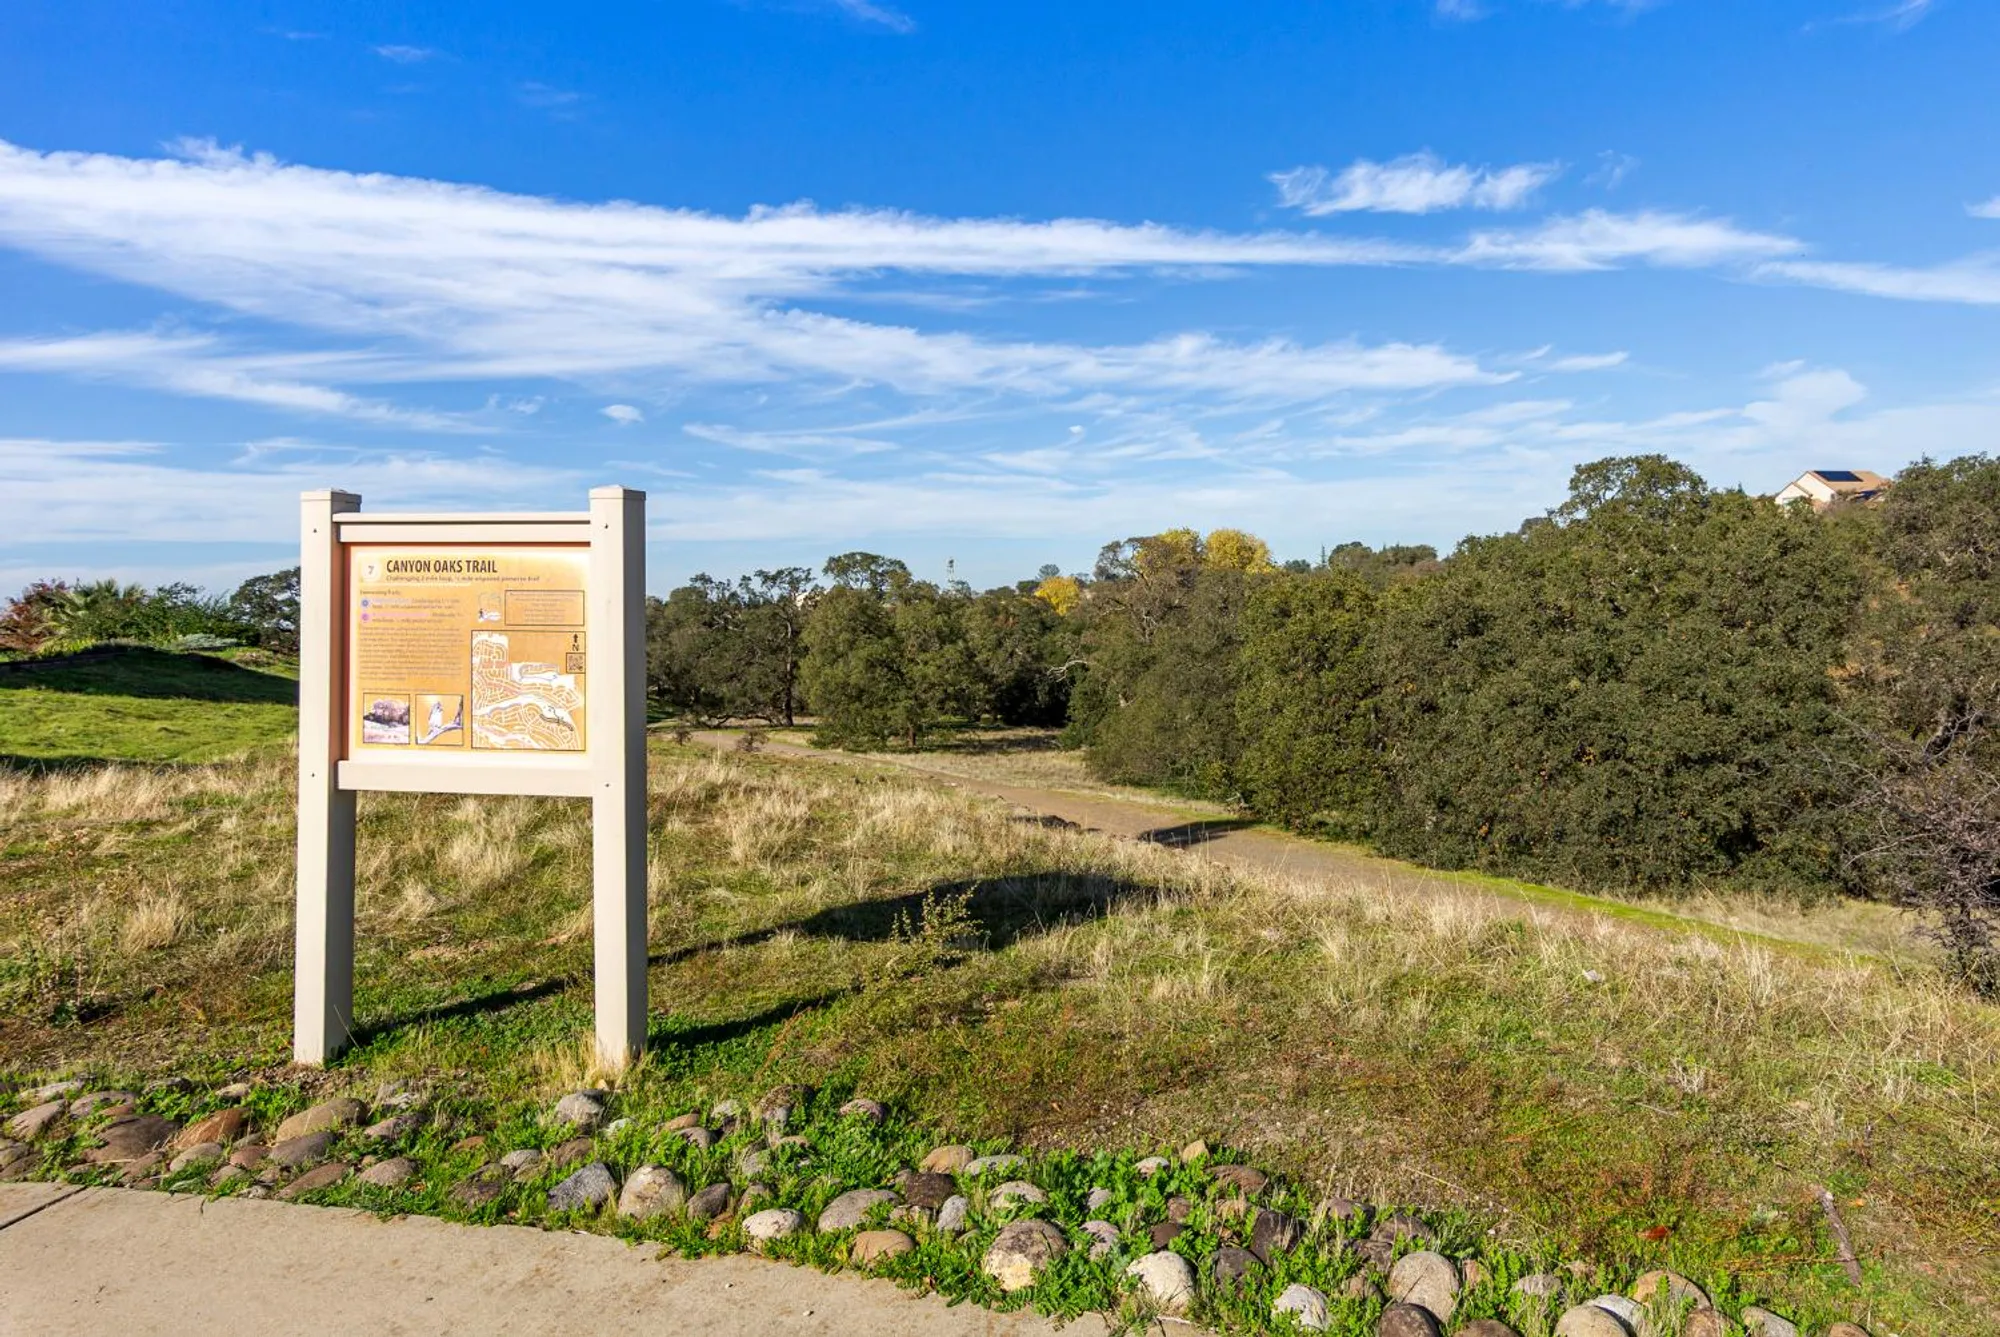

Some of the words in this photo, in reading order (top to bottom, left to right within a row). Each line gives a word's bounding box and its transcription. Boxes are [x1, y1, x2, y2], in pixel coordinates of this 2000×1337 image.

[367, 565, 375, 576] 7
[386, 560, 431, 573] CANYON
[433, 560, 463, 573] OAKS
[465, 560, 498, 573] TRAIL
